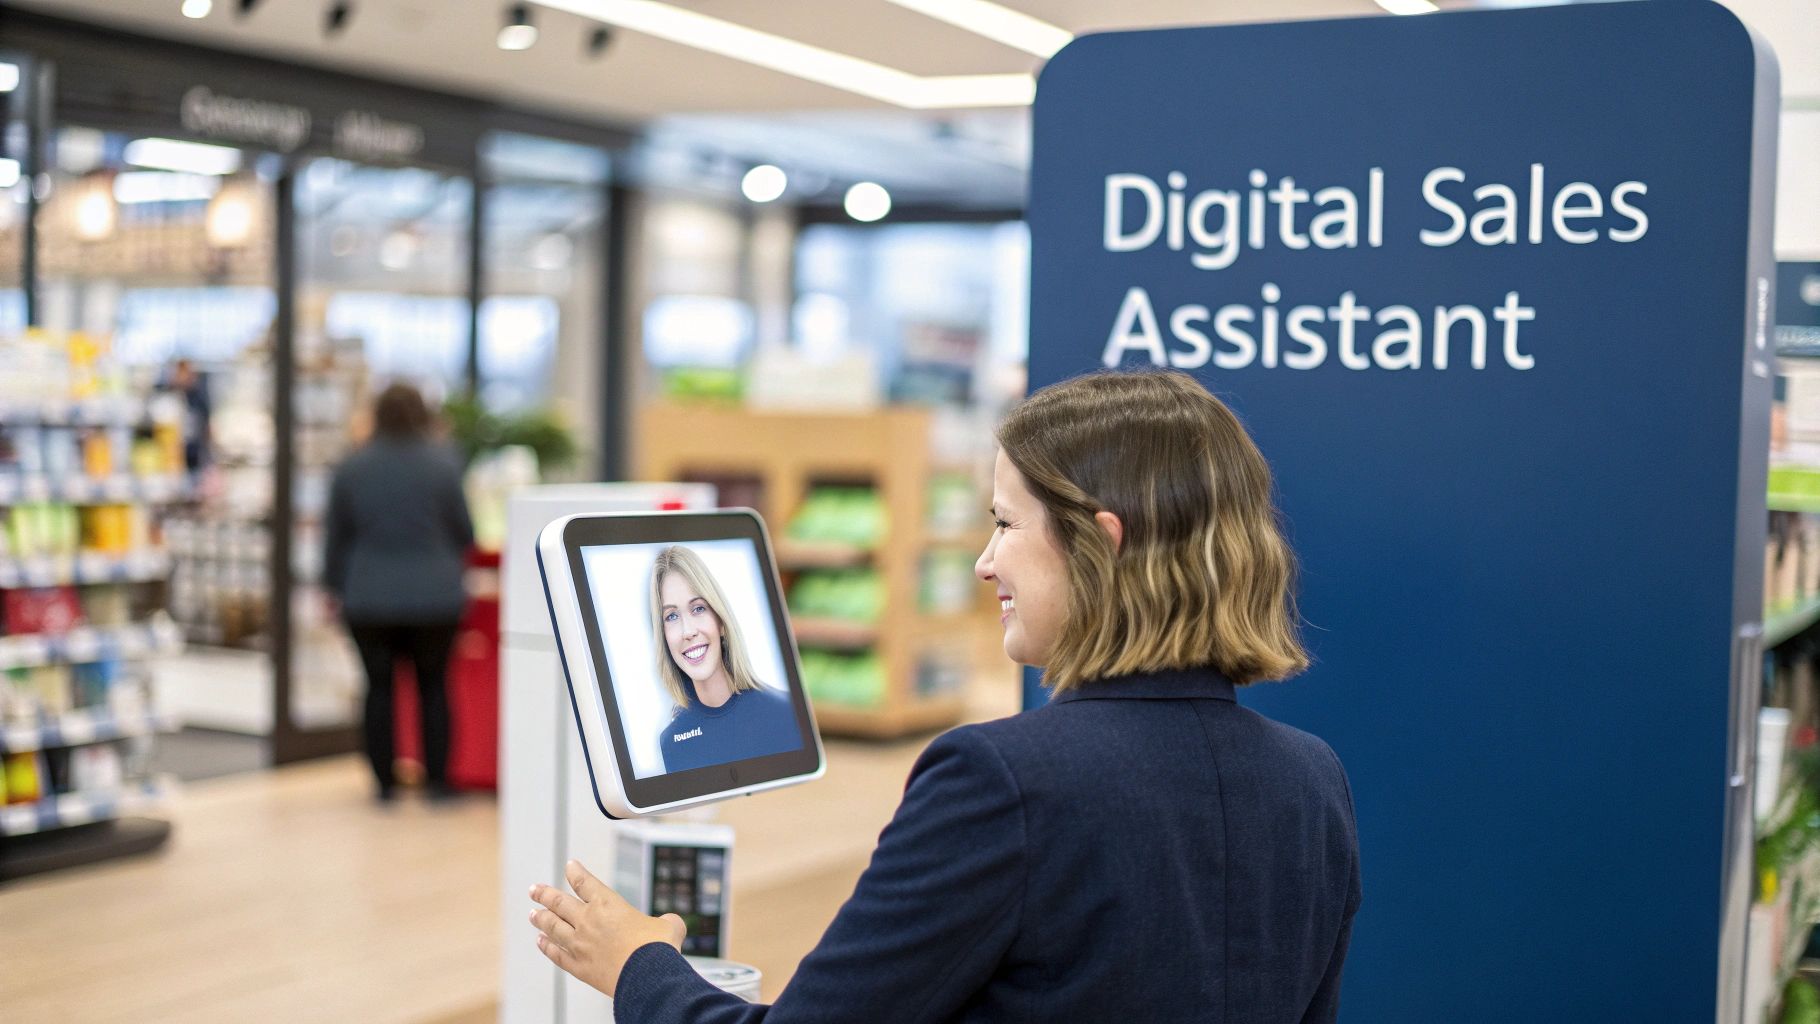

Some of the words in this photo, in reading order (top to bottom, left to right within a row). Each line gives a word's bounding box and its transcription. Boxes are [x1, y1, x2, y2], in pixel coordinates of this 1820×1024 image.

[1103, 167, 1384, 270] Digital
[1419, 163, 1649, 247] Sales
[1102, 282, 1536, 370] Assistant
